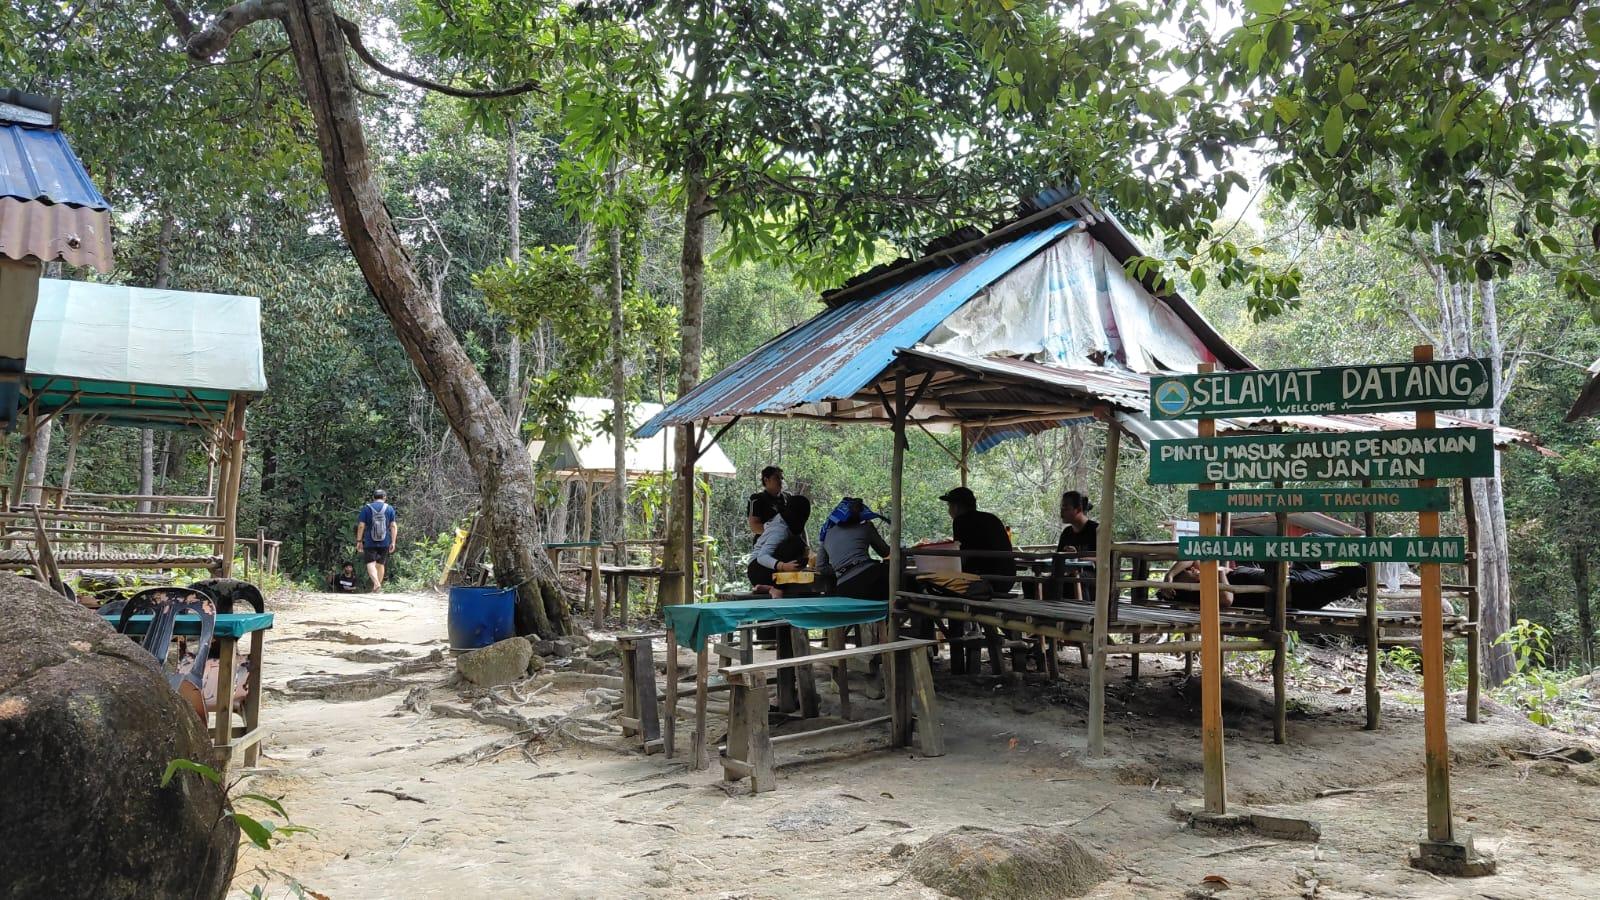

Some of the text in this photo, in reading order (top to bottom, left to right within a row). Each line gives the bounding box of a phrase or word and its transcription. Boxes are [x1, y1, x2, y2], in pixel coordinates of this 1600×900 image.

[1193, 363, 1474, 407] SELAMAT DATANG
[1277, 401, 1337, 414] WELCOME
[1160, 435, 1477, 462] PINTU MASUK JALUR PENDAKIAN
[1206, 458, 1425, 481] GUNUNG JANTAN
[1227, 493, 1401, 507] MOUNTAIN TRACKING
[1184, 540, 1459, 558] JAGALAH KELESTARIAN ALAM
